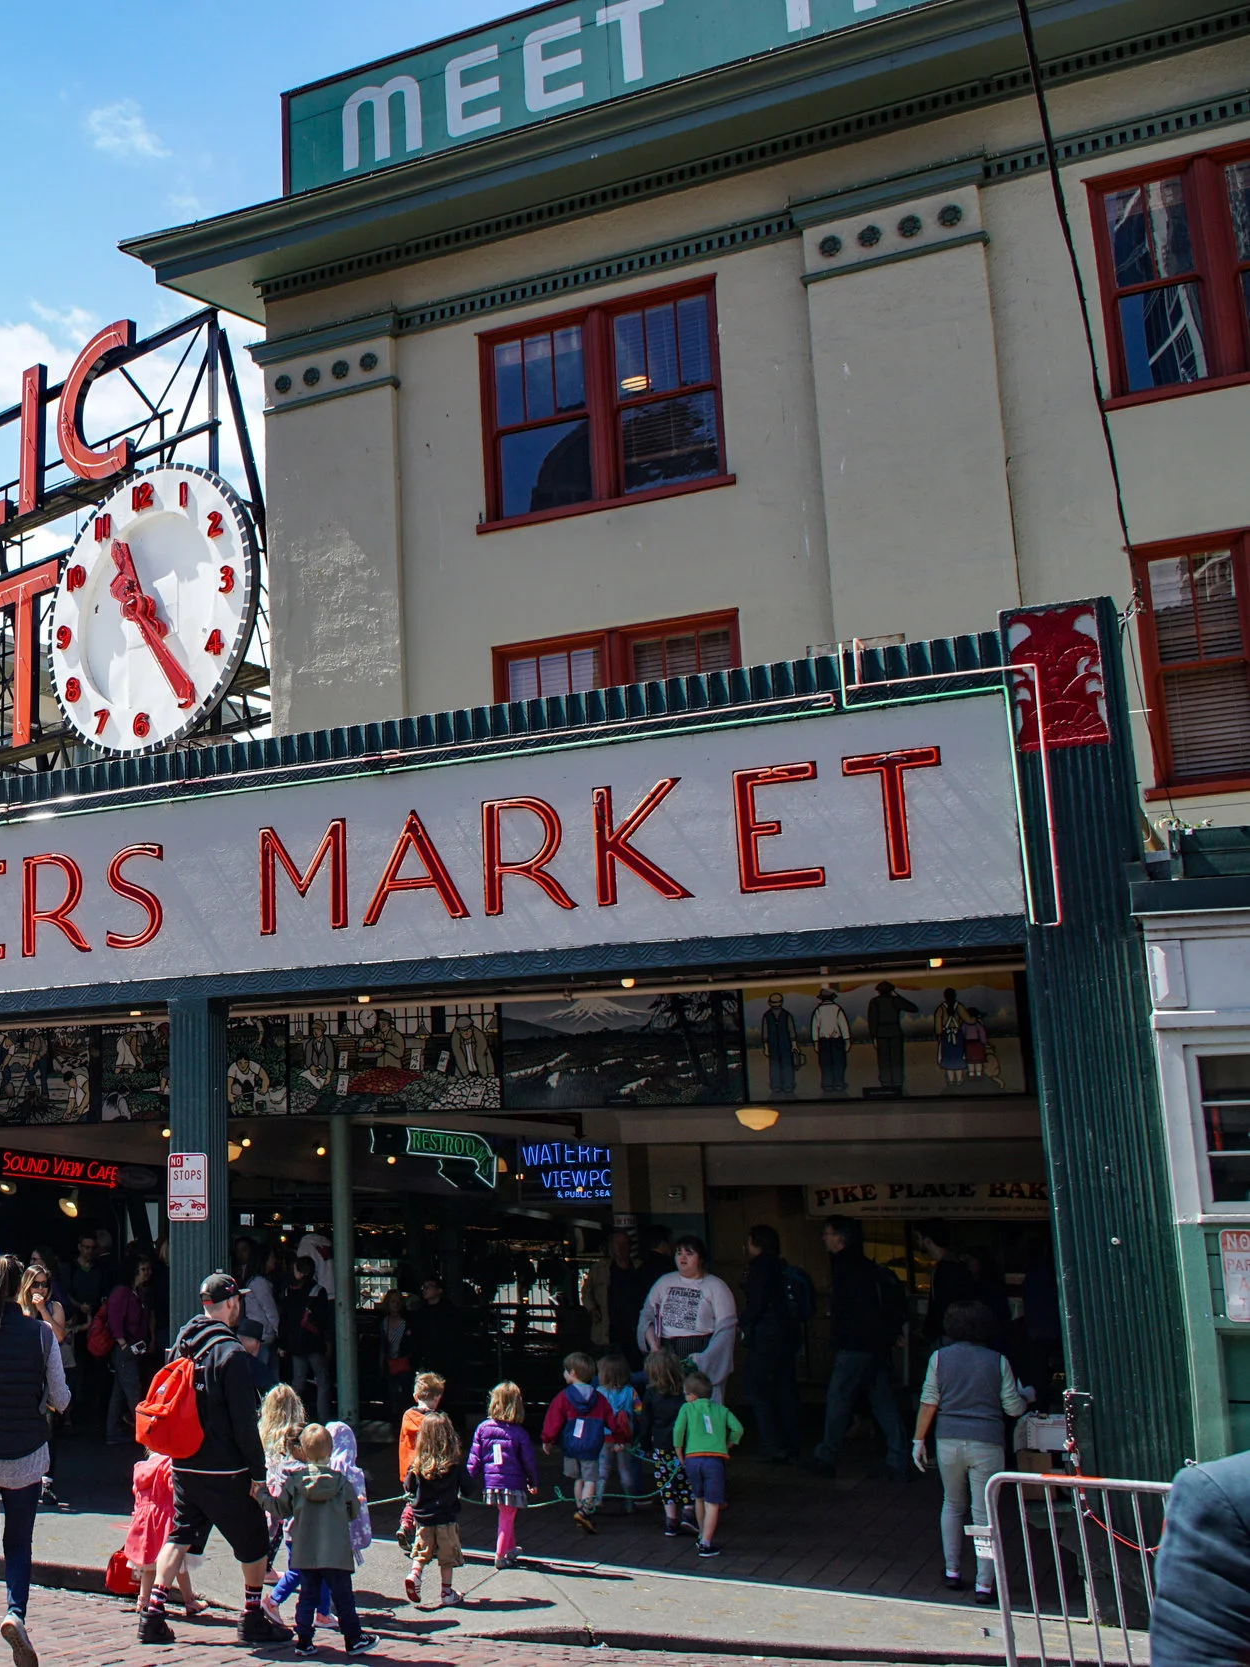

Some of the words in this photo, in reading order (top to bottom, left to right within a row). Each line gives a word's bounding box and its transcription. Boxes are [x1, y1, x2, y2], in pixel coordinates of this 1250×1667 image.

[342, 0, 664, 172] MEET
[132, 482, 153, 511] 12
[179, 482, 188, 508] 1
[94, 513, 111, 542] 11
[207, 511, 224, 538] 2
[67, 565, 86, 592] 10
[219, 565, 234, 594] 3
[56, 625, 72, 650] 9
[204, 629, 224, 655] 4
[65, 677, 81, 703] 8
[94, 709, 110, 735] 7
[133, 712, 150, 738] 6
[257, 745, 942, 937] MARKET
[2, 1151, 49, 1174] SOUND
[53, 1156, 83, 1177] VIEW
[87, 1161, 118, 1181] CAFE
[171, 1157, 181, 1166] NO
[173, 1170, 201, 1180] STOPS
[557, 1190, 563, 1198] &
[565, 1190, 592, 1198] PUBLIC
[815, 1184, 878, 1206] PIKE
[888, 1183, 978, 1200] PLACE
[1226, 1233, 1250, 1250] NO
